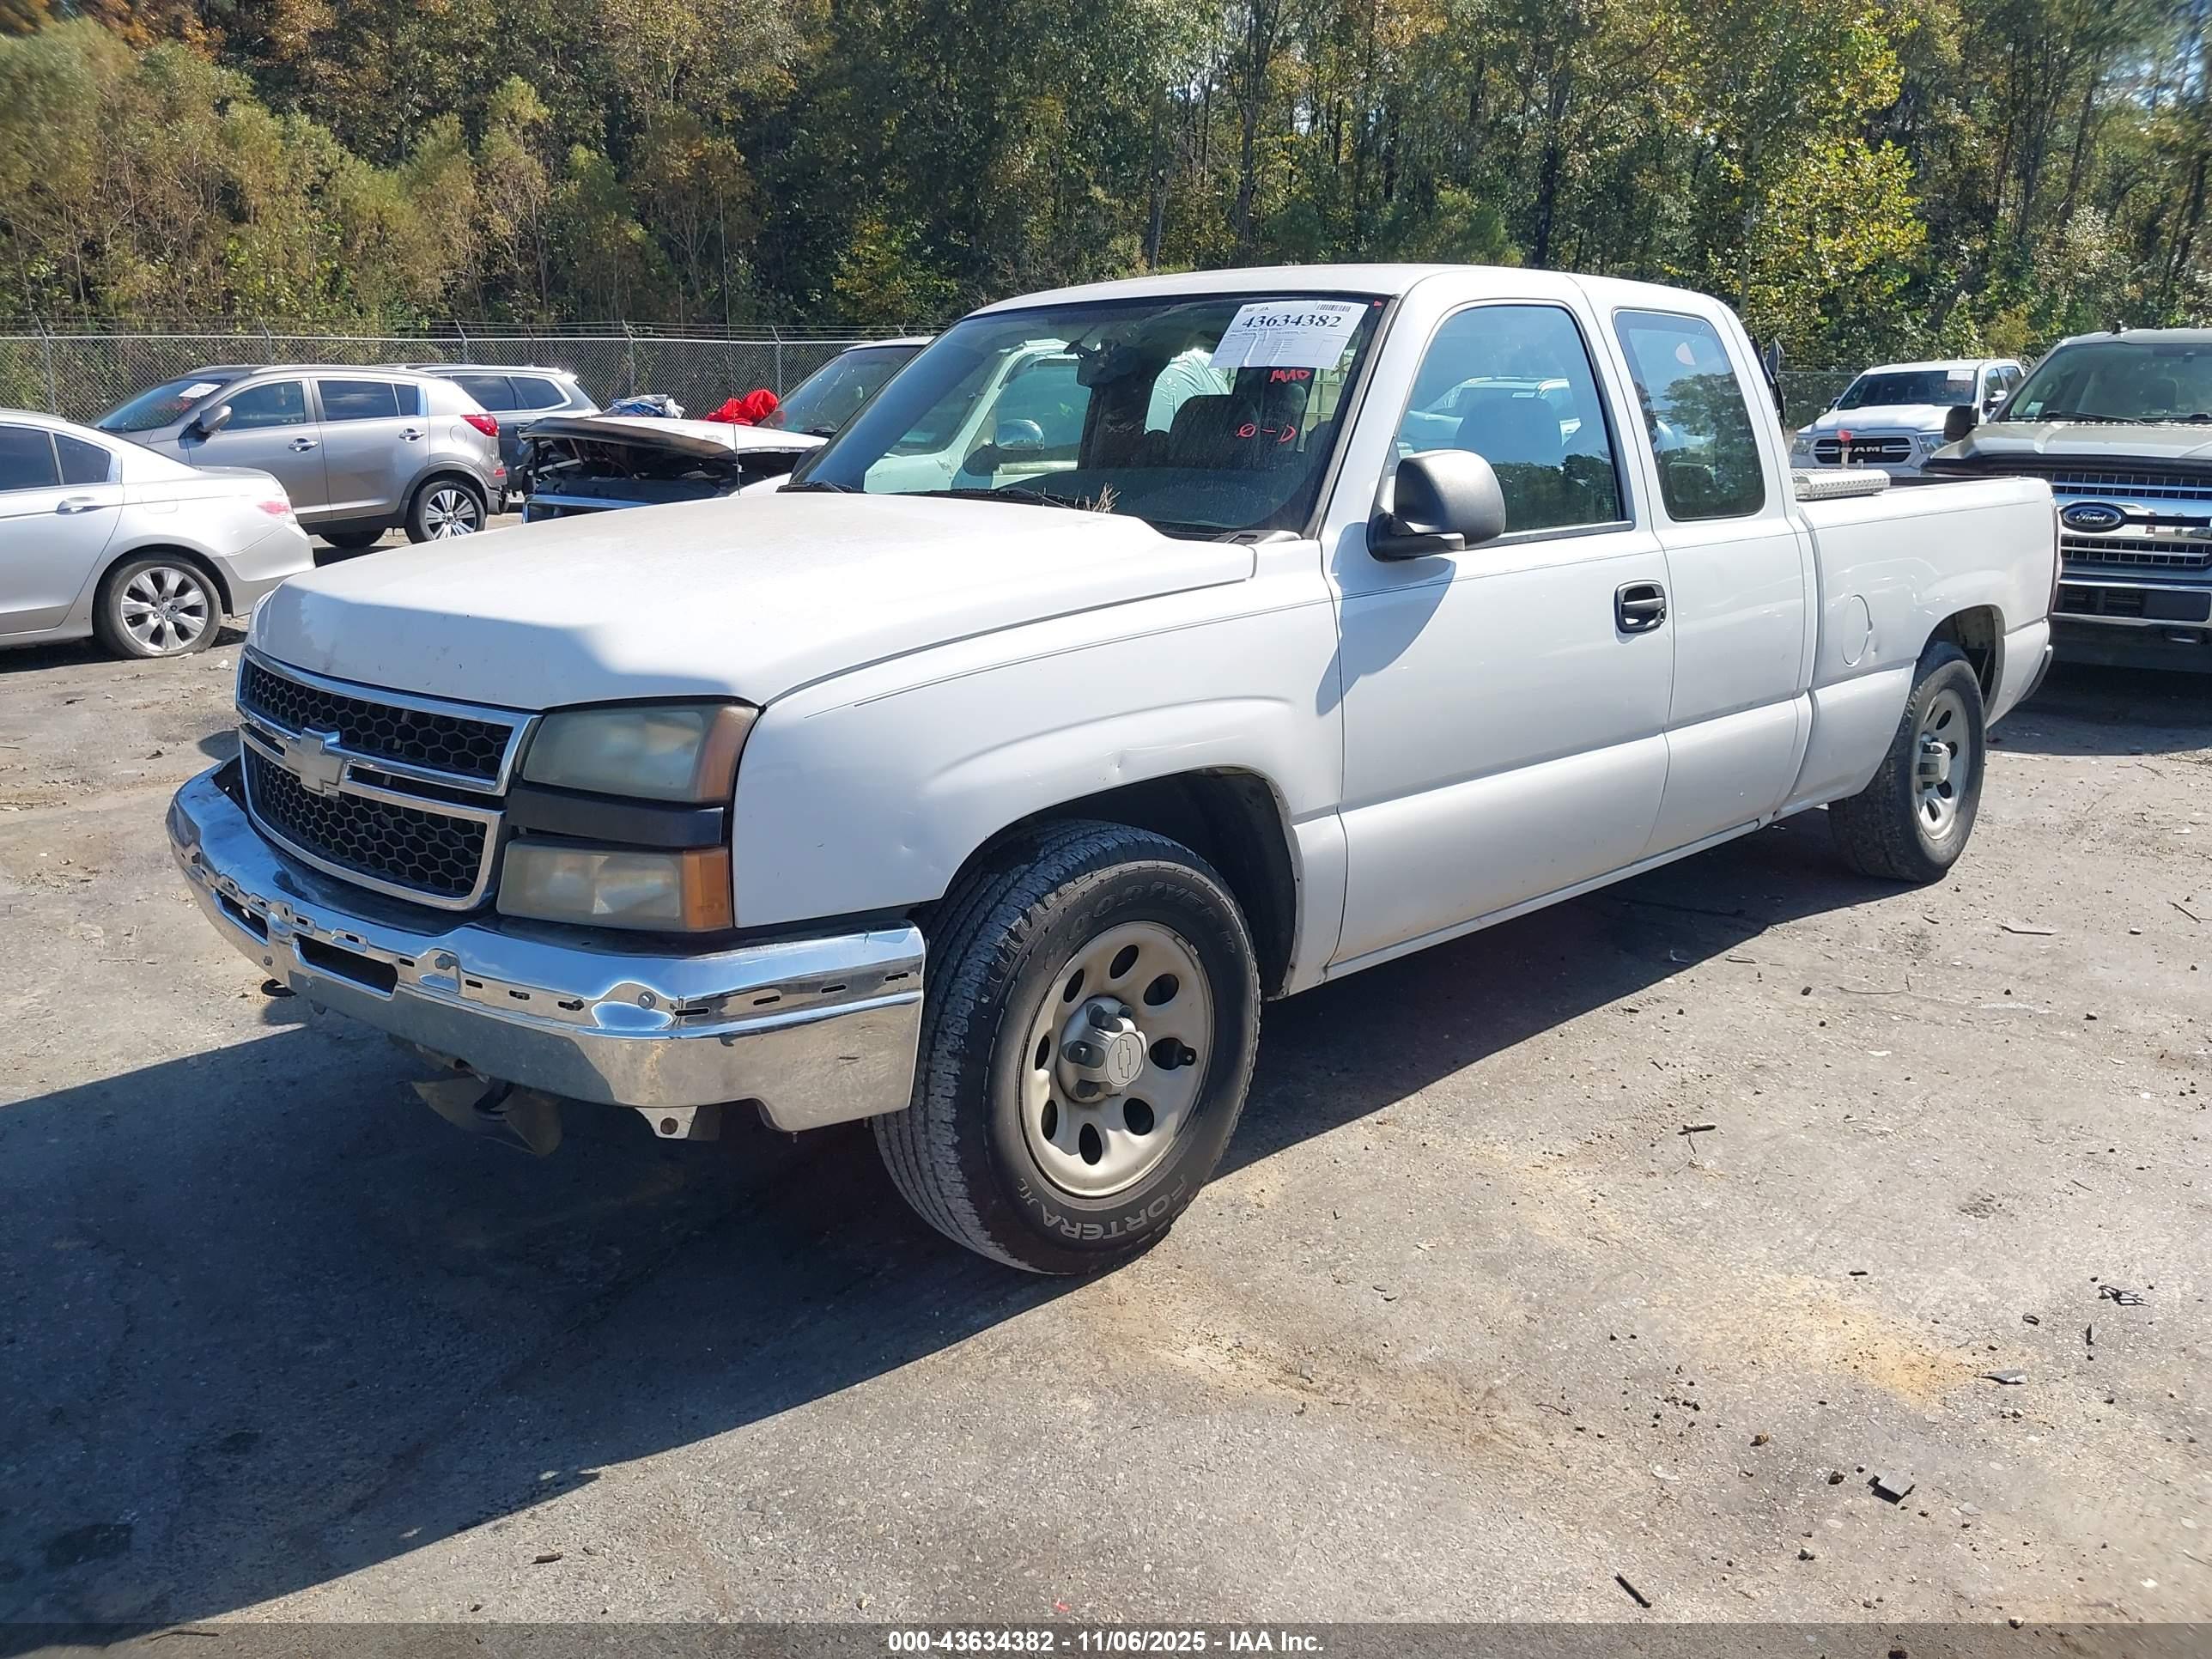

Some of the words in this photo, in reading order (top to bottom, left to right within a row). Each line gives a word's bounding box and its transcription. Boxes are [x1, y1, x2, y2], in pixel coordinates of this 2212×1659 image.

[1242, 314, 1342, 328] 43634382
[2075, 511, 2108, 522] Ford
[1041, 1173, 1188, 1241] FORTERA
